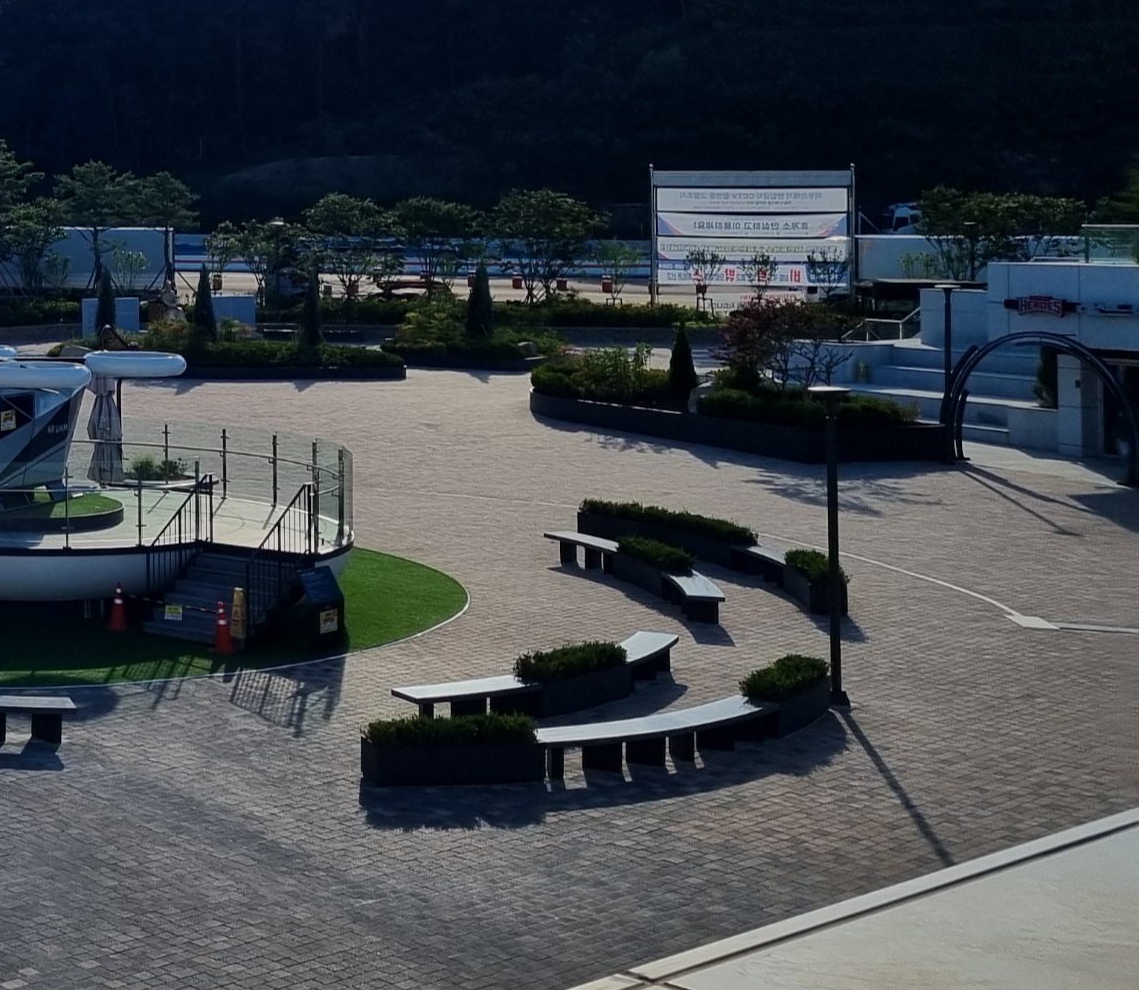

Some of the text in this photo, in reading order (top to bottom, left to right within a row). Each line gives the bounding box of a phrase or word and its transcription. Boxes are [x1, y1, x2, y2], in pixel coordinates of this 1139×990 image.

[1020, 299, 1061, 314] HEROES
[47, 424, 69, 434] KR UAM
